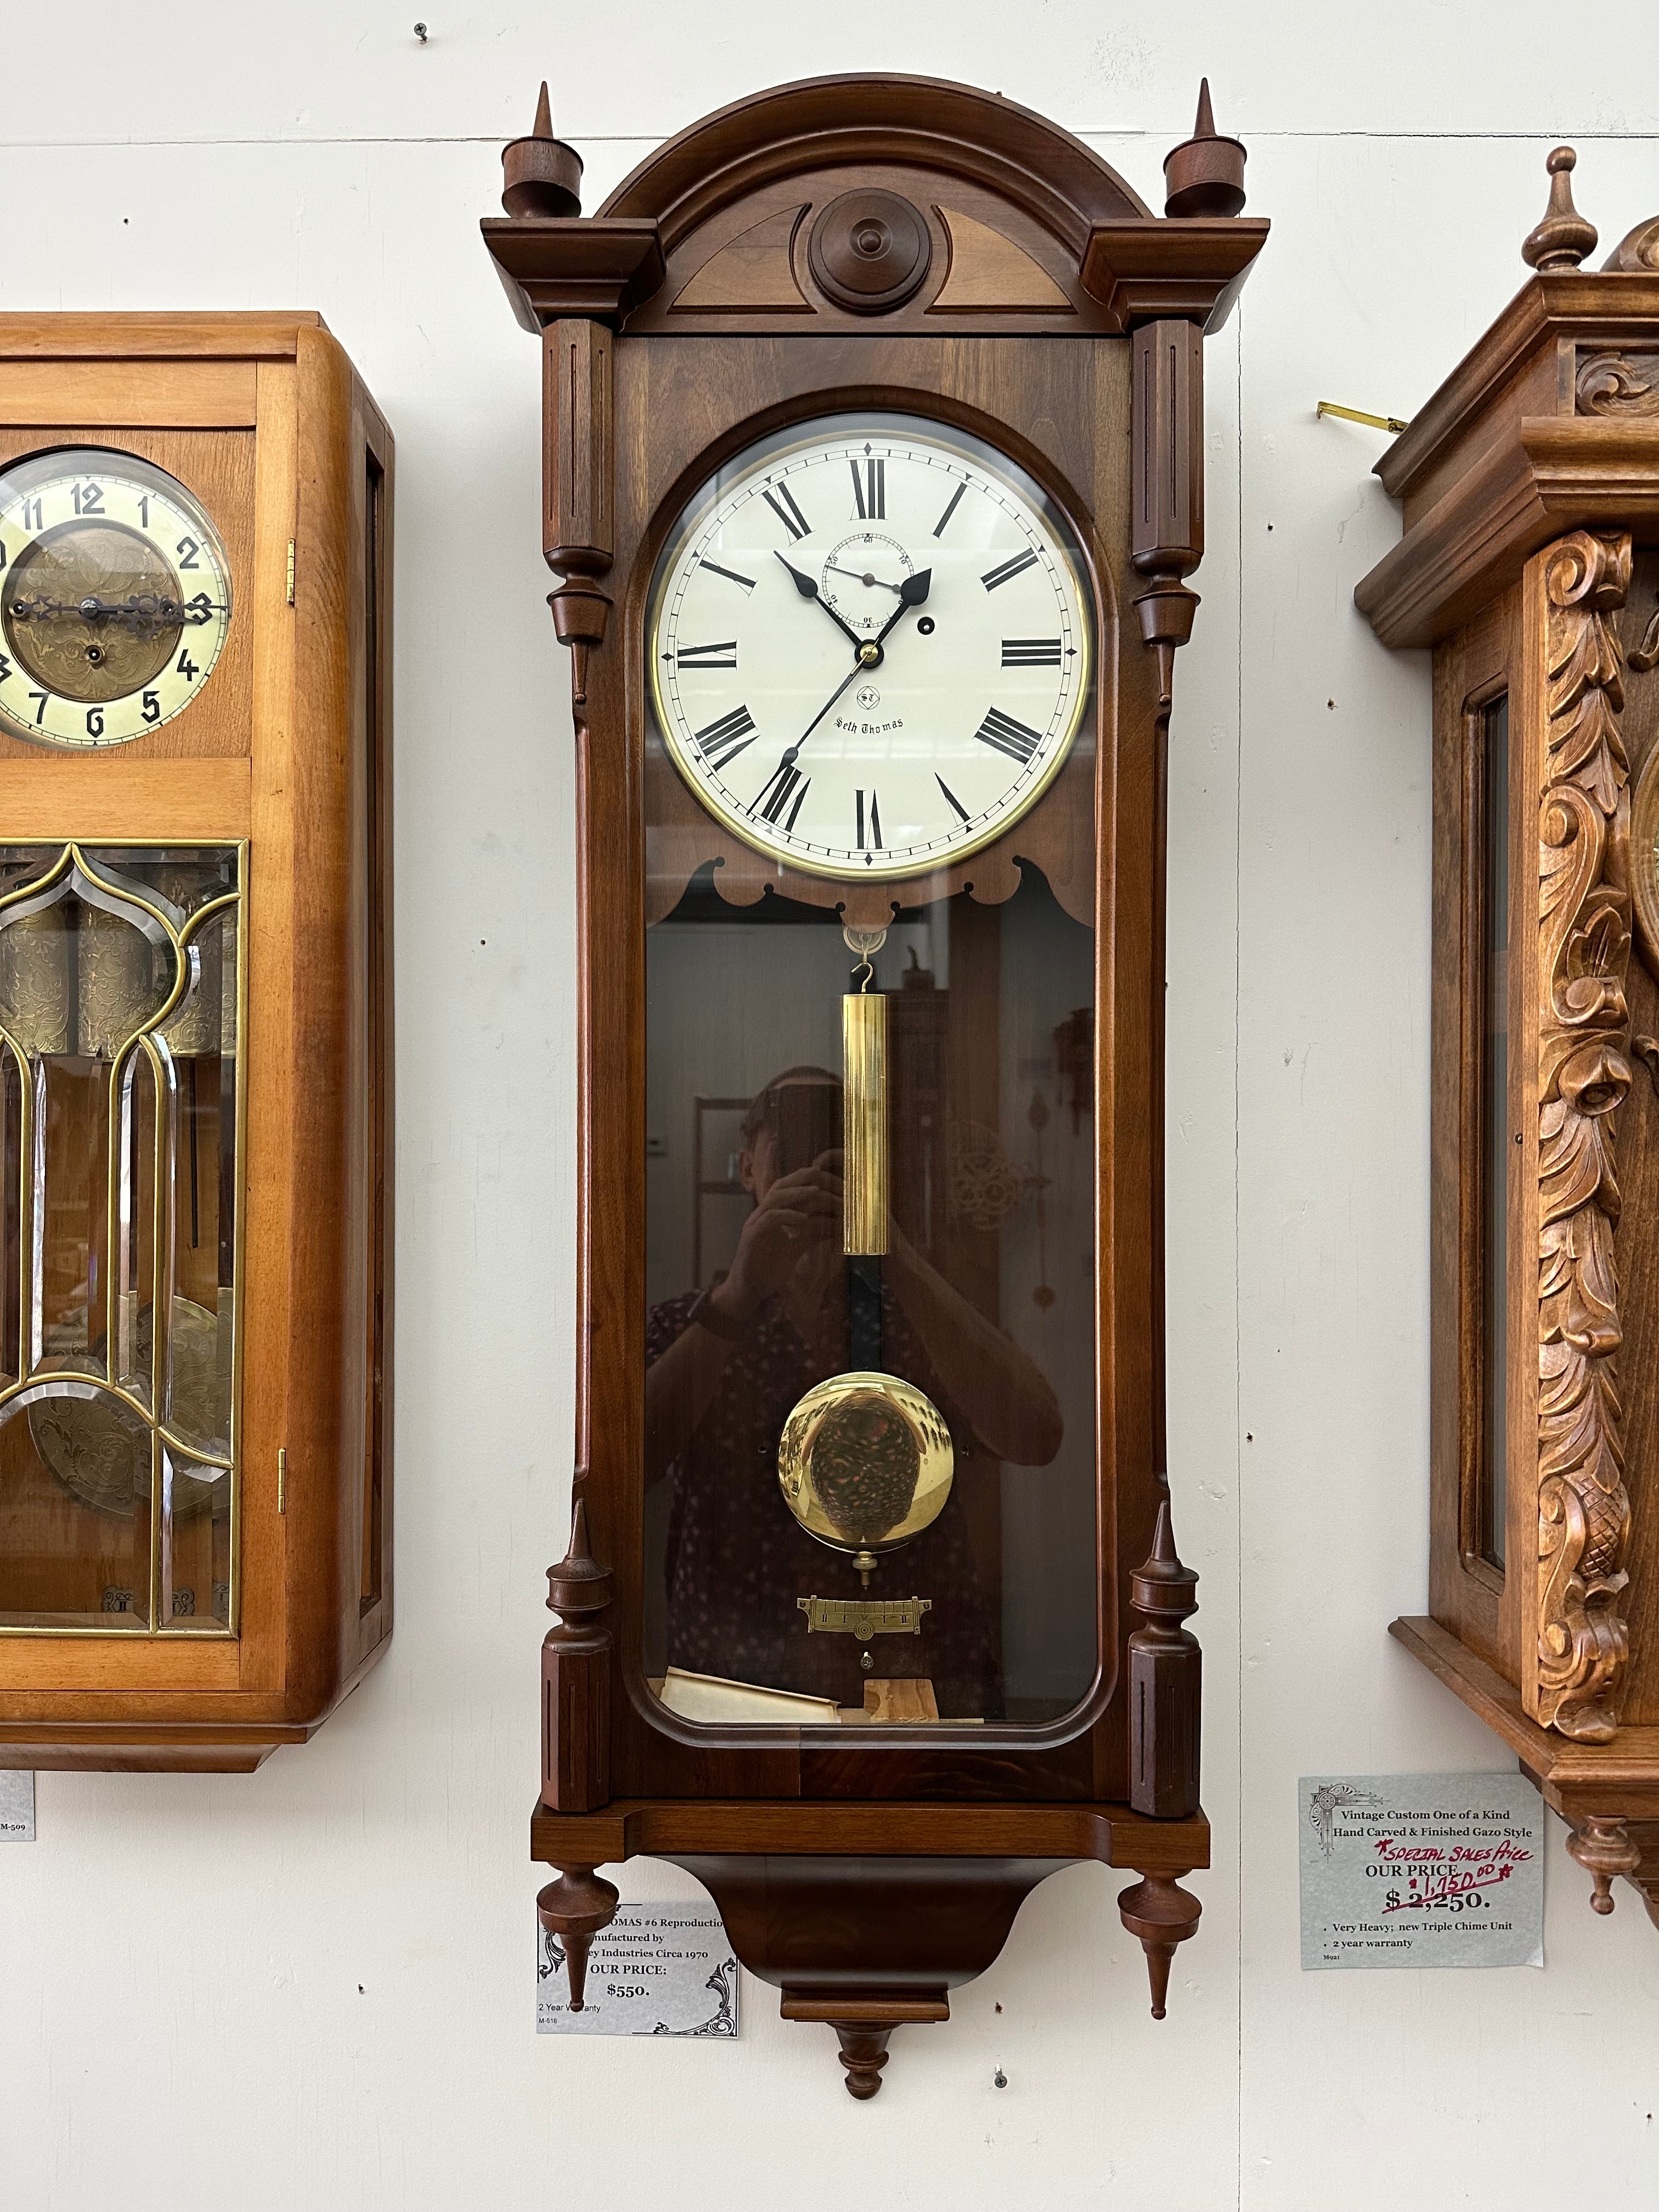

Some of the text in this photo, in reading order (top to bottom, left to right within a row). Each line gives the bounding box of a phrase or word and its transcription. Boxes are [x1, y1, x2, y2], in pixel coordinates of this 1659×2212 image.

[70, 482, 105, 515] 12
[21, 498, 43, 530] 11
[138, 495, 149, 528] 1
[177, 536, 200, 569] 2
[177, 650, 199, 681] 4
[29, 692, 50, 724] 7
[141, 691, 160, 723] 5
[87, 707, 104, 737] 6
[861, 718, 904, 735] Thomas
[1341, 1810, 1384, 1821] Vintage
[1387, 1810, 1430, 1819] Custom
[1459, 1810, 1472, 1819] of
[1482, 1810, 1510, 1819] Kind
[1333, 1827, 1364, 1836] Hand
[1367, 1827, 1406, 1836] Carved
[1421, 1827, 1470, 1836] Finished
[1473, 1827, 1501, 1836] Gazo
[1504, 1828, 1532, 1838] Style
[1366, 1865, 1403, 1877] OUR
[659, 1918, 723, 1928] Reproductio
[1333, 1924, 1356, 1933] Very
[1359, 1924, 1393, 1933] Heavy;
[1422, 1922, 1452, 1932] Triple
[1455, 1922, 1487, 1930] Chime
[594, 1933, 664, 1944] nufactured by
[1366, 1940, 1413, 1949] warranty
[602, 1949, 653, 1957] Industries
[656, 1949, 682, 1957] Circa
[591, 1965, 666, 1974] OUR PRICE:
[607, 1983, 649, 1997] $550.
[565, 2003, 601, 2014] Wanty
